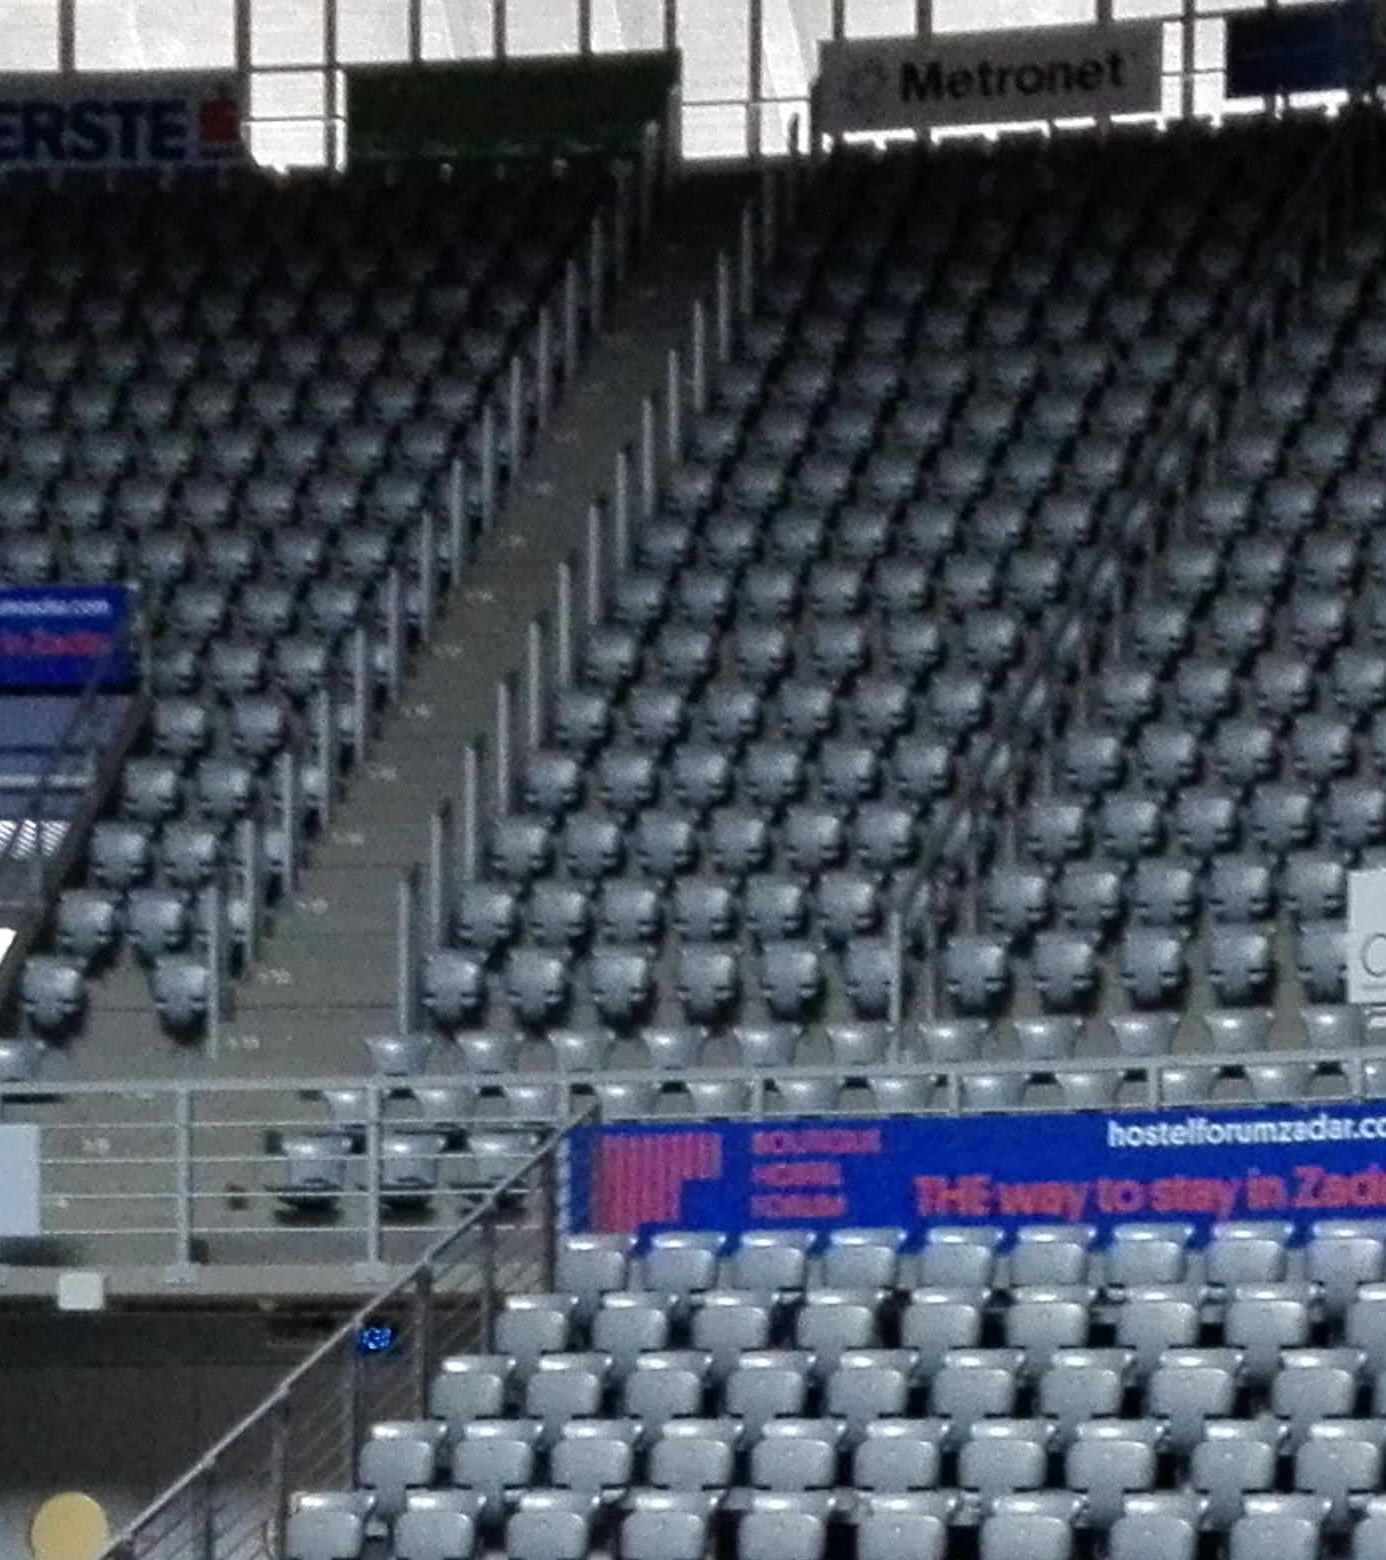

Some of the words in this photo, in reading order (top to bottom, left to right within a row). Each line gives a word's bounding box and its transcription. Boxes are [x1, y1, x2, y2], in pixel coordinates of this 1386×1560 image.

[899, 49, 1126, 104] Metronet
[1097, 1176, 1144, 1214] to
[1150, 1174, 1241, 1222] stay
[1245, 1167, 1286, 1209] in
